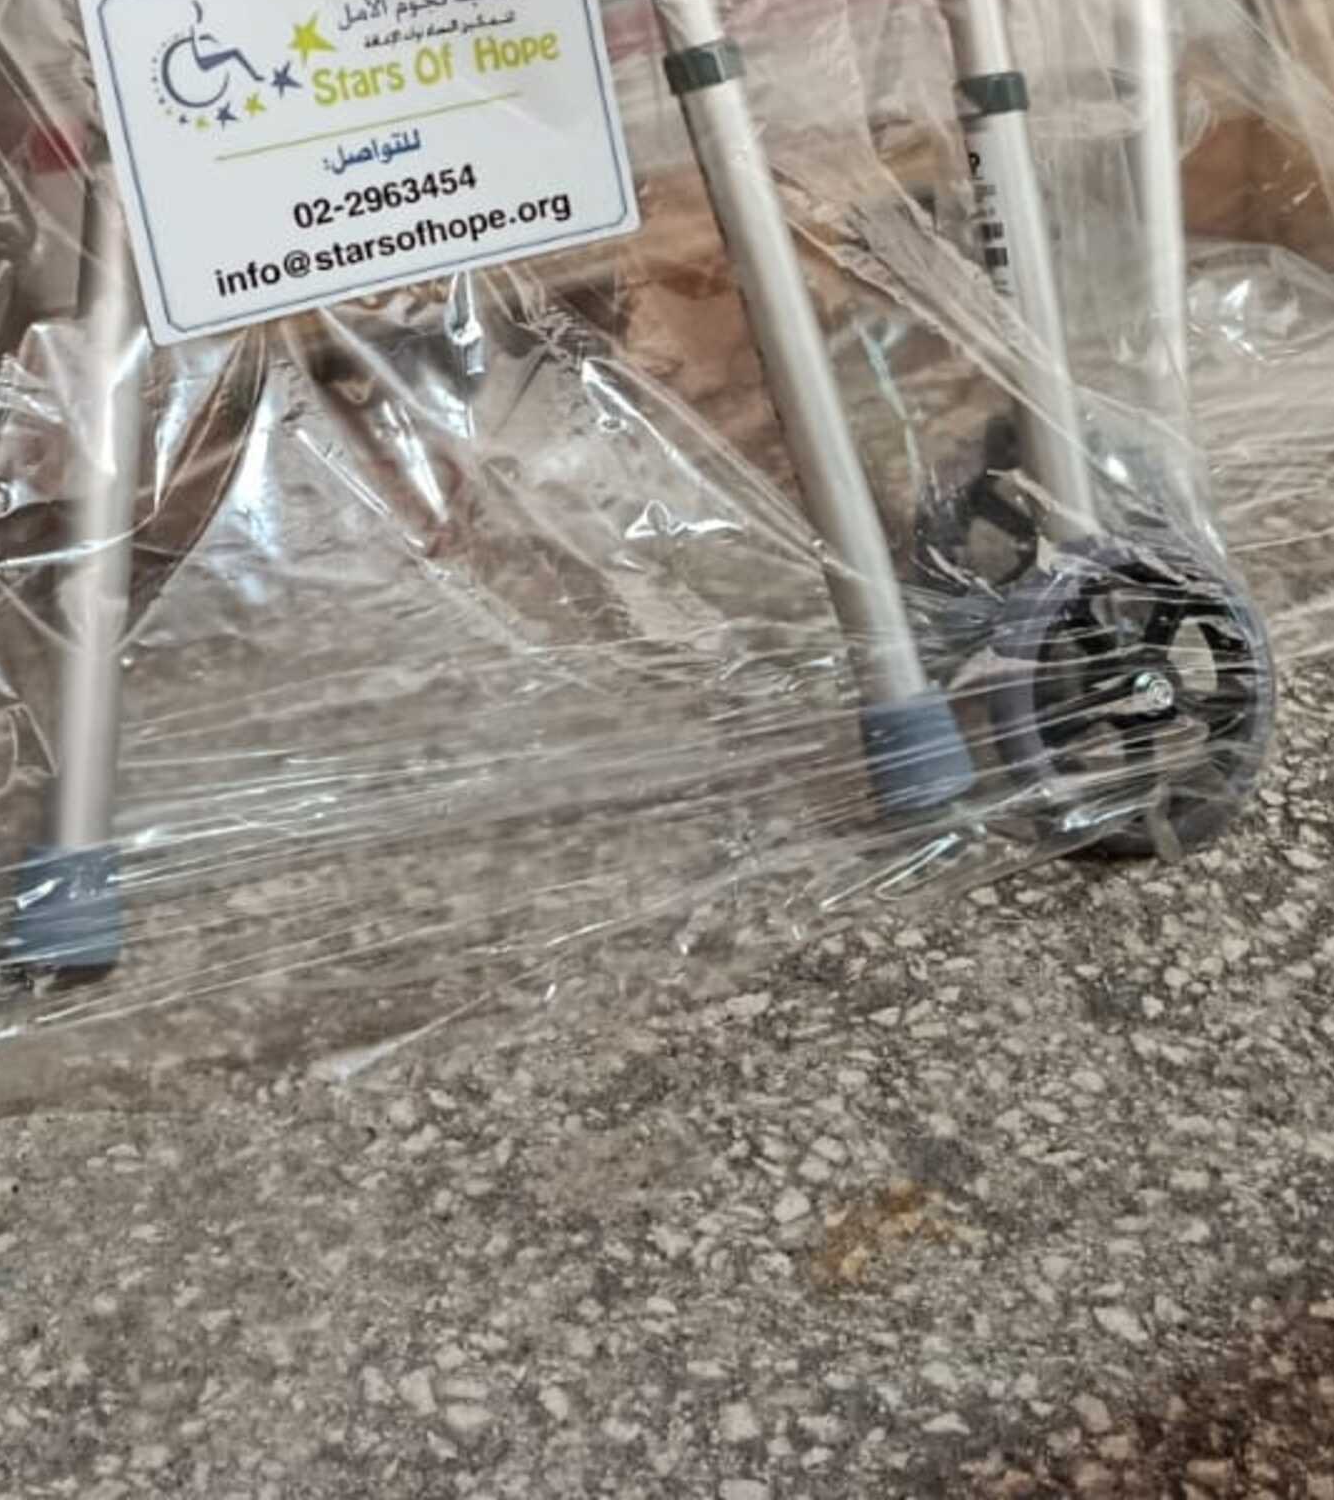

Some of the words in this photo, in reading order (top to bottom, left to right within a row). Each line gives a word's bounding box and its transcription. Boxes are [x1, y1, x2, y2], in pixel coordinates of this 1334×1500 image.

[312, 58, 405, 107] Stars
[414, 42, 453, 86] Of
[473, 31, 560, 76] Hope
[293, 163, 478, 231] 02-2963454
[214, 192, 573, 299] info@starsofhope.org
